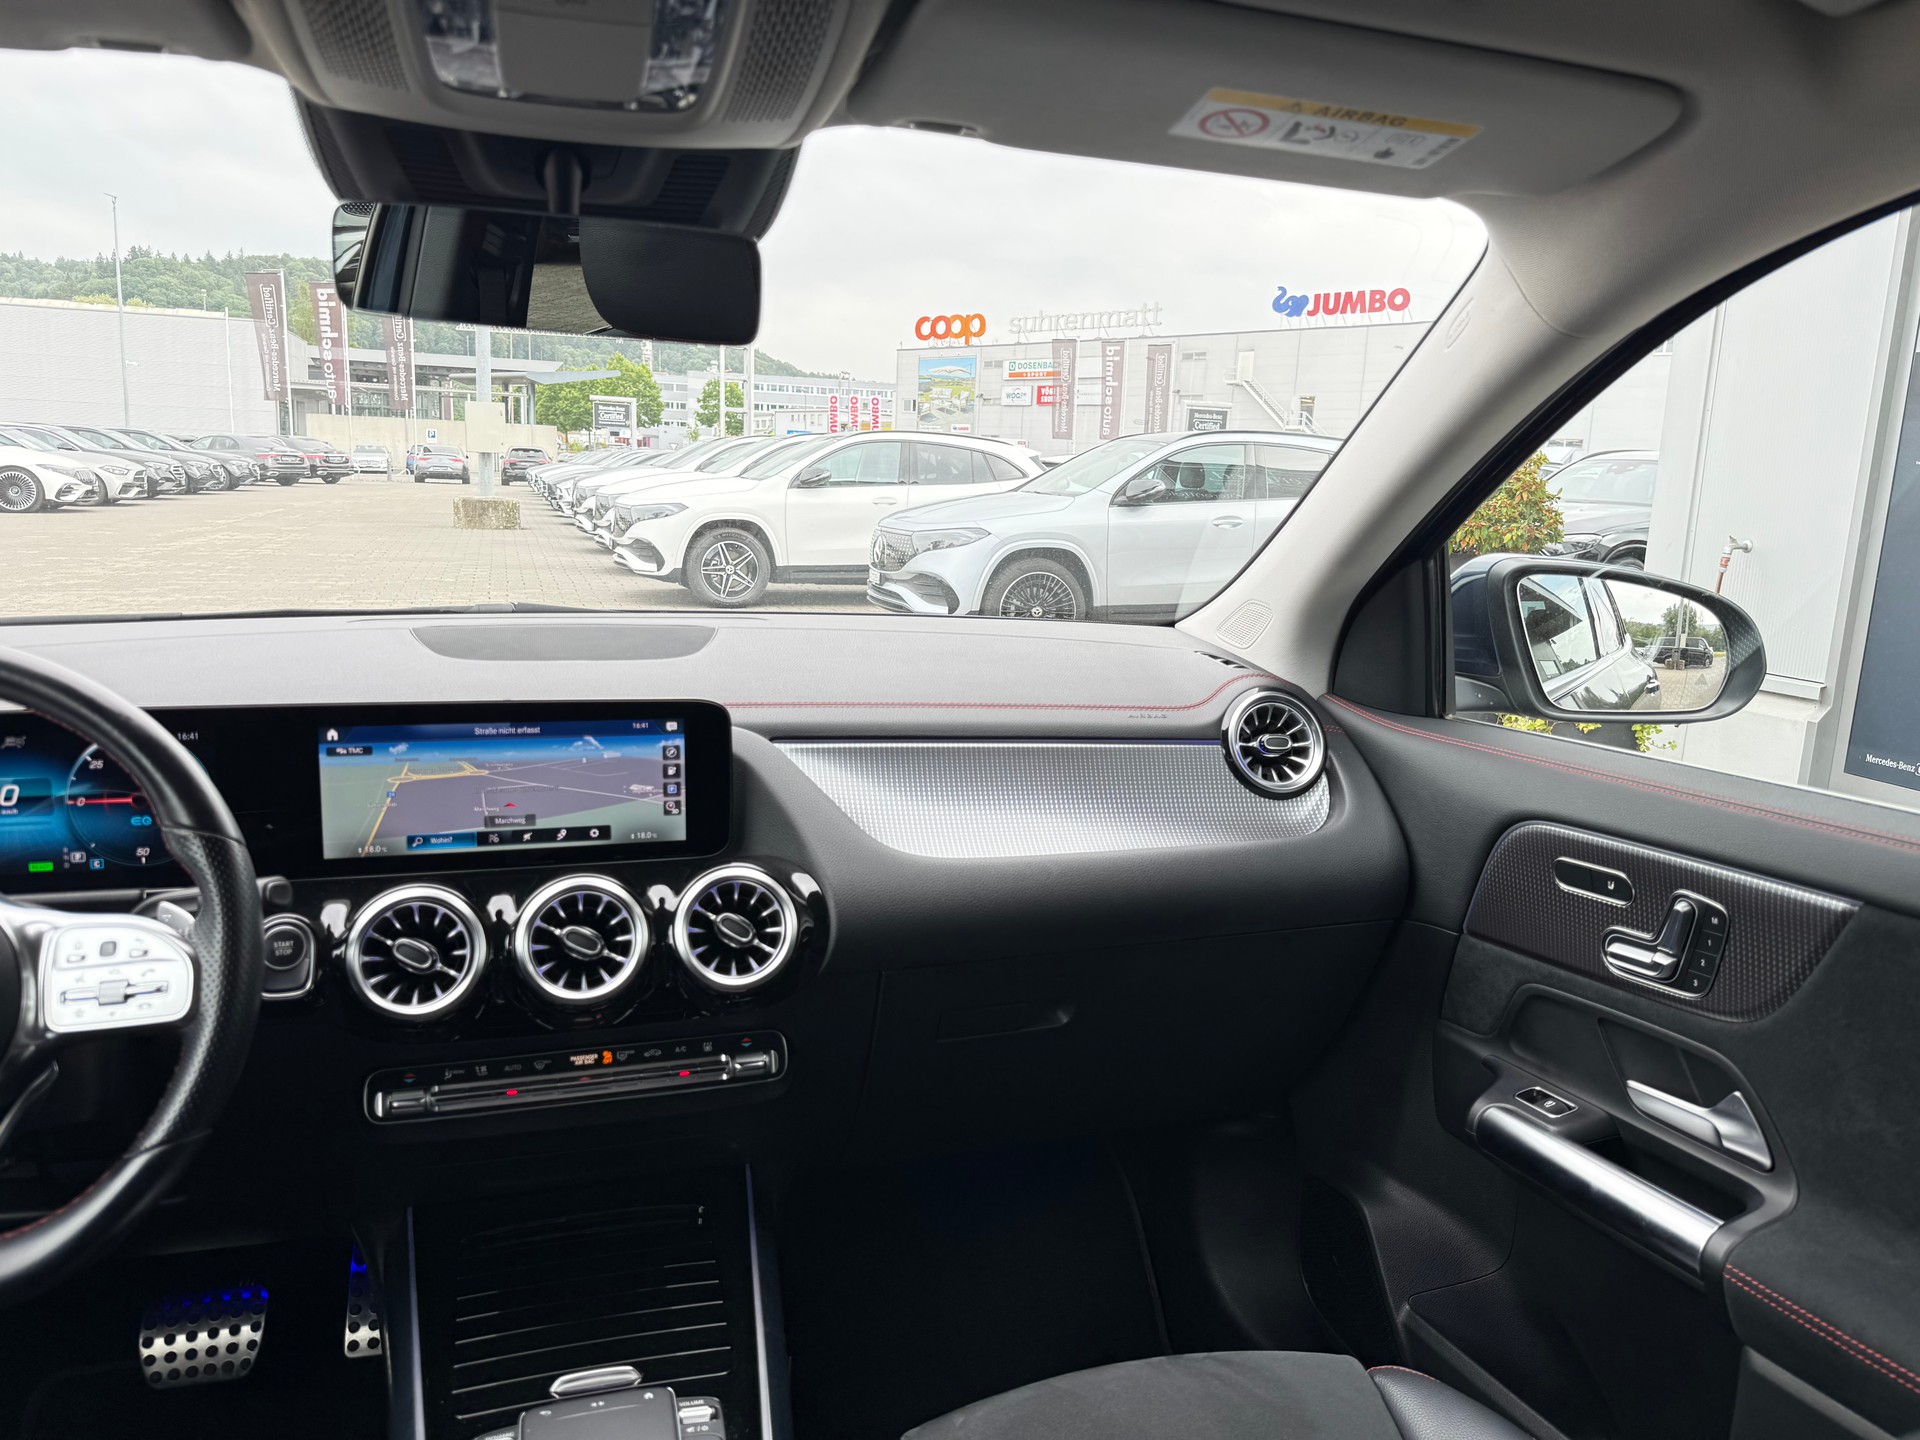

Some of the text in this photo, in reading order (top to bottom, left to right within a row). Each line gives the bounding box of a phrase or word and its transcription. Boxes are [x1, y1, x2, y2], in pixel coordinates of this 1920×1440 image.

[1314, 105, 1407, 127] AIRBAG
[1307, 288, 1411, 317] JUMBO
[1009, 302, 1162, 334] suhrenmatt
[914, 313, 987, 346] coop
[474, 726, 541, 735] Straße nicht erfasst
[177, 732, 199, 740] 16:41
[89, 760, 104, 770] 25
[1865, 753, 1916, 773] Mercedes-Benz
[0, 785, 20, 807] 0
[130, 815, 152, 826] EQ
[495, 817, 526, 825] Marchweg
[1711, 917, 1718, 925] M
[273, 940, 294, 948] START
[275, 948, 292, 956] STOP
[1700, 959, 1705, 967] 2
[1693, 979, 1698, 987] 3
[569, 1053, 598, 1062] PASSENGER
[504, 1064, 522, 1072] AUTO
[679, 1399, 705, 1407] VOLUME
